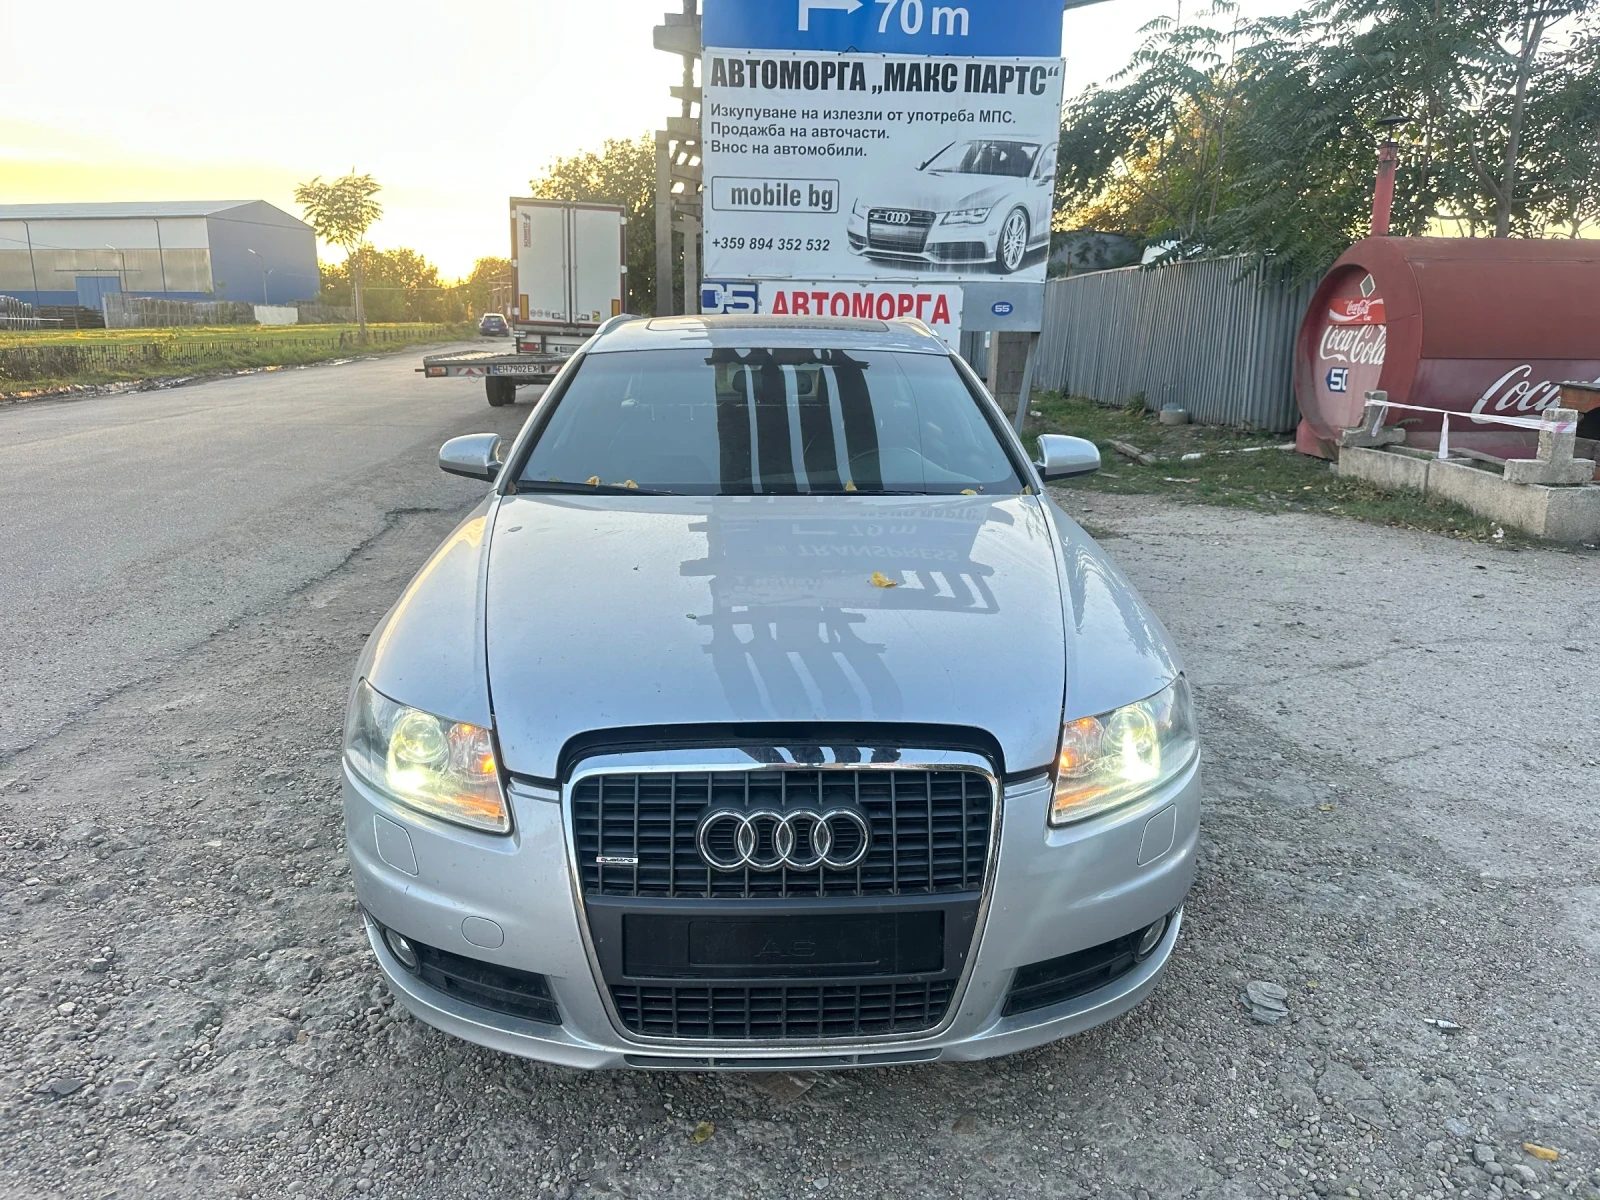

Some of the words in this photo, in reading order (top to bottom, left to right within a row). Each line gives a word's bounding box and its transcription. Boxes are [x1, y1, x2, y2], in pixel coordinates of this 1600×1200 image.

[875, 0, 923, 34] 70
[931, 6, 970, 36] m
[710, 58, 866, 91] АВТОМОРГА
[710, 103, 797, 121] Изкупуване
[801, 109, 819, 120] на
[823, 110, 883, 122] излезли
[887, 111, 904, 122] от
[907, 109, 975, 125] употреба
[979, 110, 1017, 124] МПС.
[711, 121, 786, 140] Продажба
[790, 127, 808, 138] на
[812, 128, 890, 140] авточасти.
[711, 140, 748, 155] Внос
[752, 145, 770, 155] на
[774, 143, 867, 158] автомобили.
[731, 182, 801, 207] mobile
[809, 184, 833, 211] bg
[712, 237, 746, 250] +359
[749, 237, 774, 251] 894
[777, 238, 802, 252] 352
[806, 239, 831, 252] 532
[772, 290, 951, 325] АВТОМОРГА
